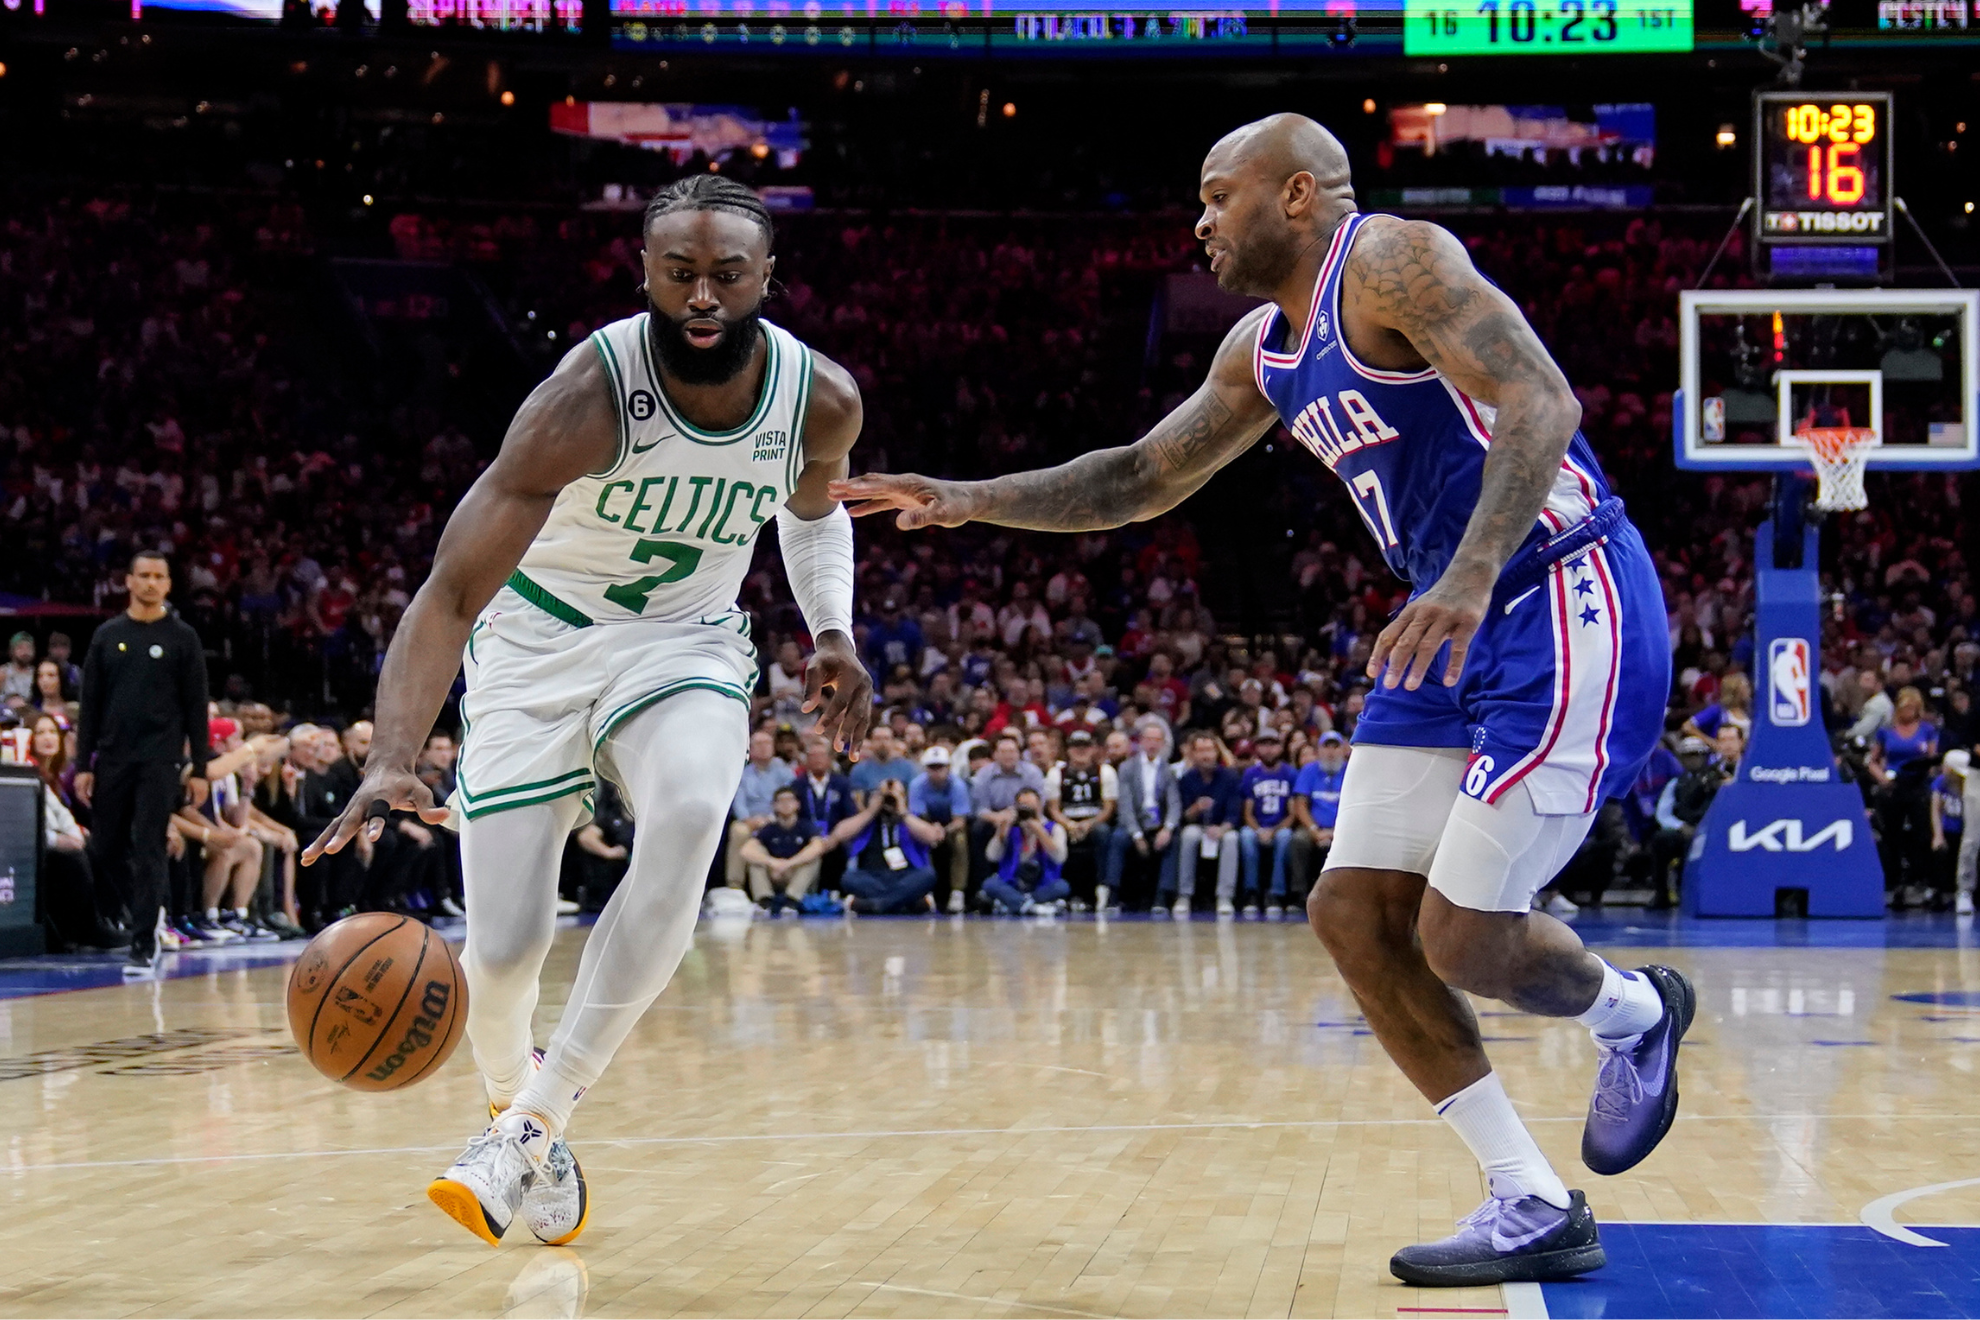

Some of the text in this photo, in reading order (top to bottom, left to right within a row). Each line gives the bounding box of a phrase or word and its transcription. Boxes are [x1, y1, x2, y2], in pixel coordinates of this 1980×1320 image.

[1478, 0, 1618, 43] 10:23
[1786, 104, 1875, 143] 10:23
[1808, 142, 1865, 205] 16
[1799, 212, 1884, 231] TISSOT
[633, 394, 650, 418] 6
[752, 448, 786, 462] PRINT
[755, 430, 786, 449] VISTA
[595, 476, 777, 546] CELTICS
[603, 538, 704, 615] 7
[1750, 766, 1831, 785] Google Pixel
[1728, 819, 1853, 852] KIA
